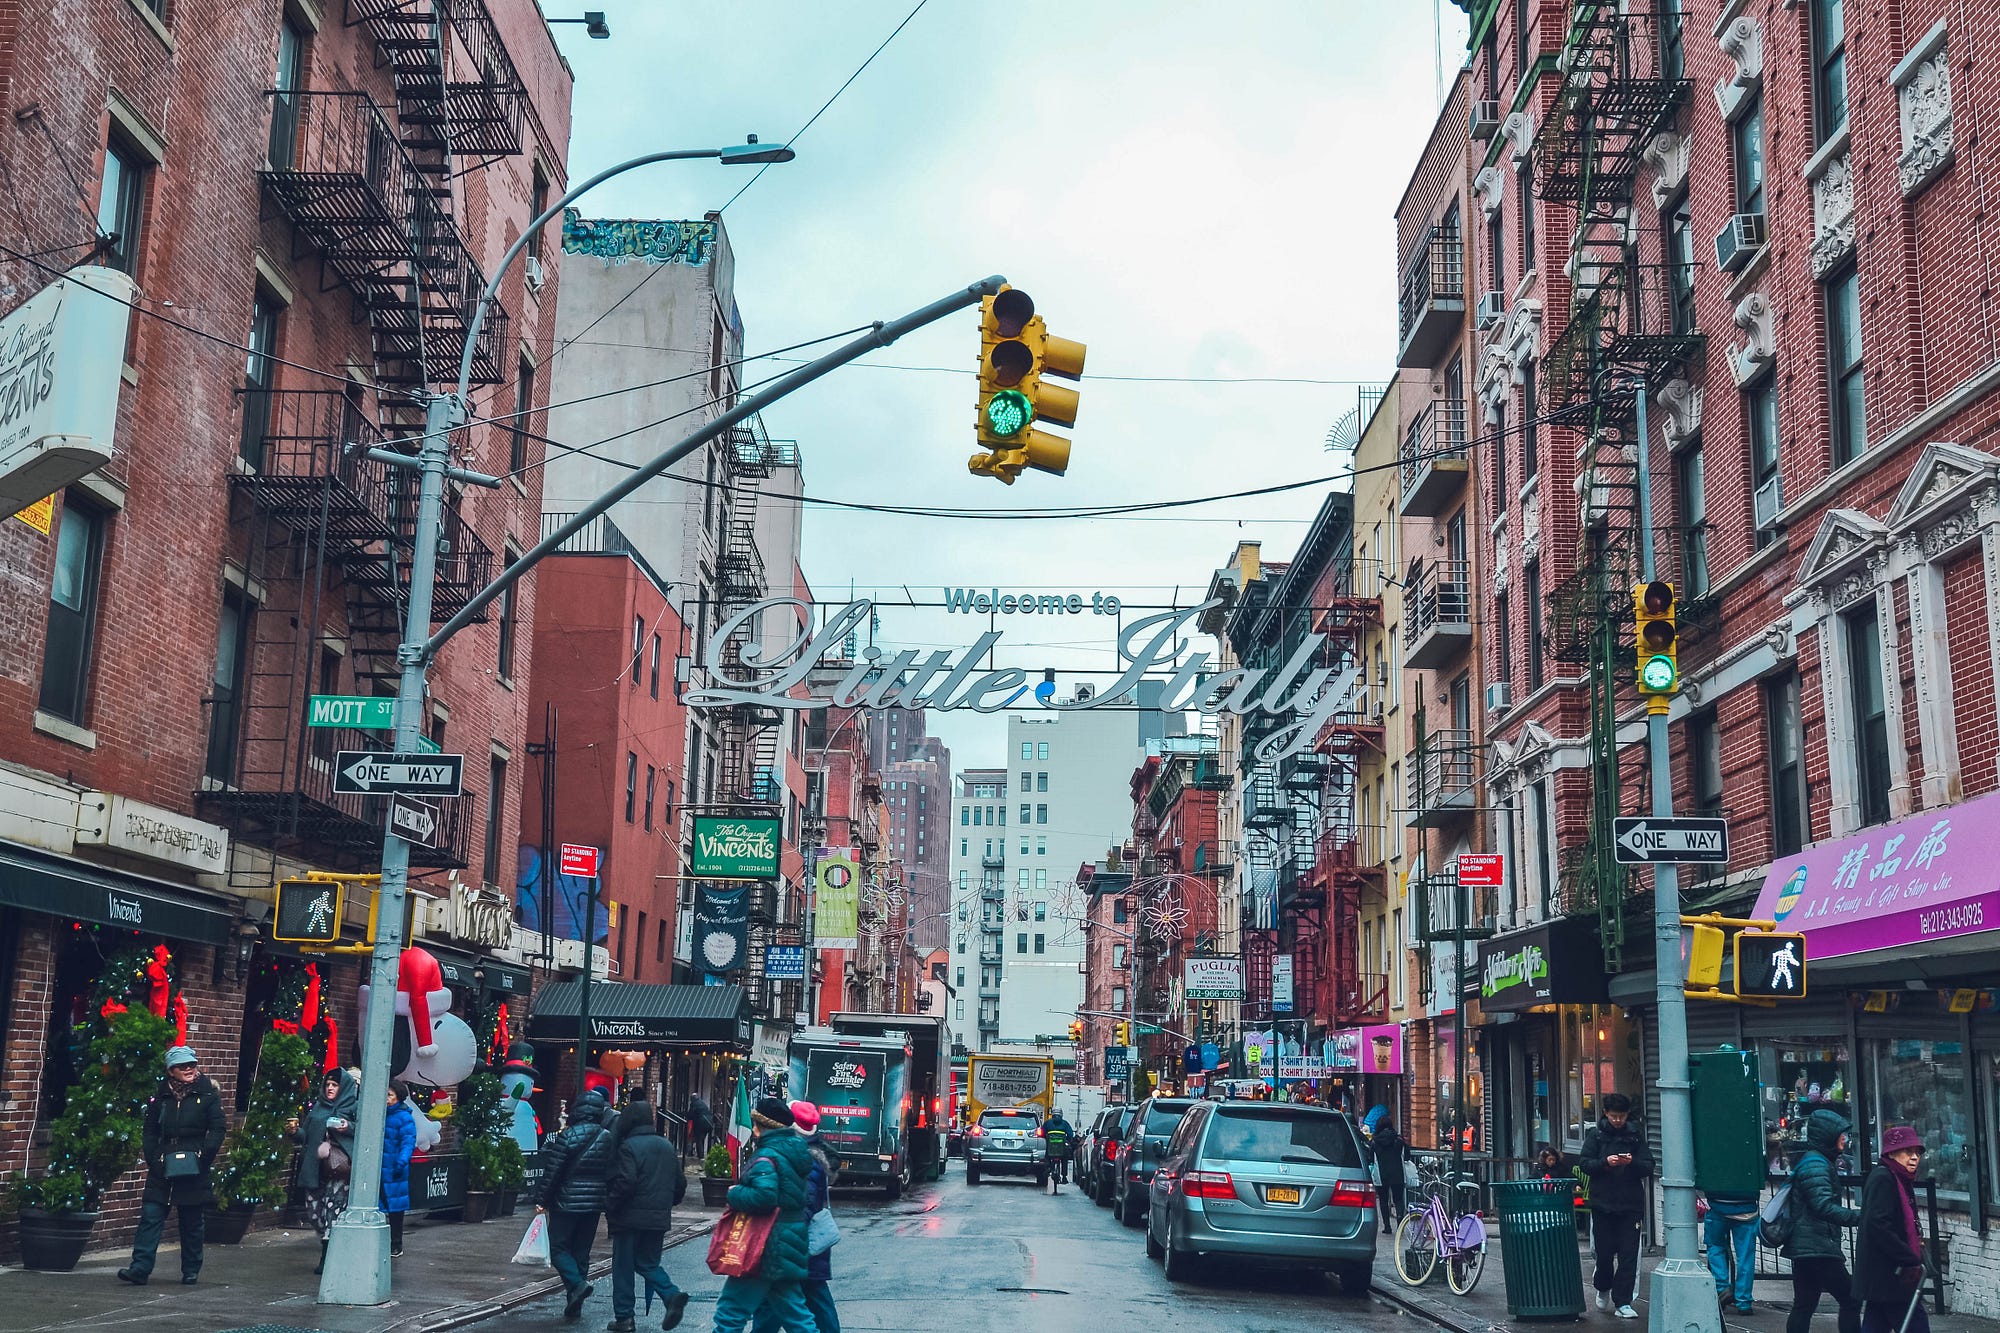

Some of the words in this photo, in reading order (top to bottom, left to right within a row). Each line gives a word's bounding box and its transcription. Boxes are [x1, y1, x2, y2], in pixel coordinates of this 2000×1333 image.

[945, 587, 1082, 615] Welcome
[1091, 589, 1121, 615] to
[681, 597, 1030, 713] Little
[1034, 598, 1368, 763] Italy
[314, 700, 366, 724] MOTT
[377, 702, 391, 714] ST
[356, 765, 390, 781] ONE
[408, 767, 445, 782] WAY
[397, 805, 410, 826] ONE
[415, 814, 431, 833] WAY
[715, 824, 734, 837] The
[735, 824, 772, 843] Original
[1631, 832, 1667, 848] ONE
[1684, 832, 1717, 848] WAY
[571, 848, 593, 857] STANDING
[698, 833, 775, 860] Vincent's
[1832, 819, 1952, 889] 精品廊
[1460, 865, 1483, 873] Anytime
[1866, 888, 1877, 908] &
[1879, 884, 1900, 910] Gift
[1903, 877, 1930, 899] Shop
[109, 892, 142, 923] Vincent's
[1919, 903, 1984, 935] Tel:212-343-0925
[1191, 961, 1240, 975] PUGLIA
[591, 1018, 645, 1036] Vincent's
[832, 1061, 857, 1074] Safety
[1110, 1065, 1127, 1073] SPA
[1281, 1057, 1303, 1066] T-SHIRT
[1311, 1057, 1319, 1066] for
[835, 1070, 851, 1079] Fire
[997, 1068, 1037, 1076] NORTHEAST
[1259, 1068, 1274, 1076] COLO
[1281, 1068, 1303, 1076] T-SHIRT
[1311, 1068, 1320, 1076] for
[827, 1075, 865, 1087] Sprinkler
[983, 1083, 1037, 1092] 718-861-7550
